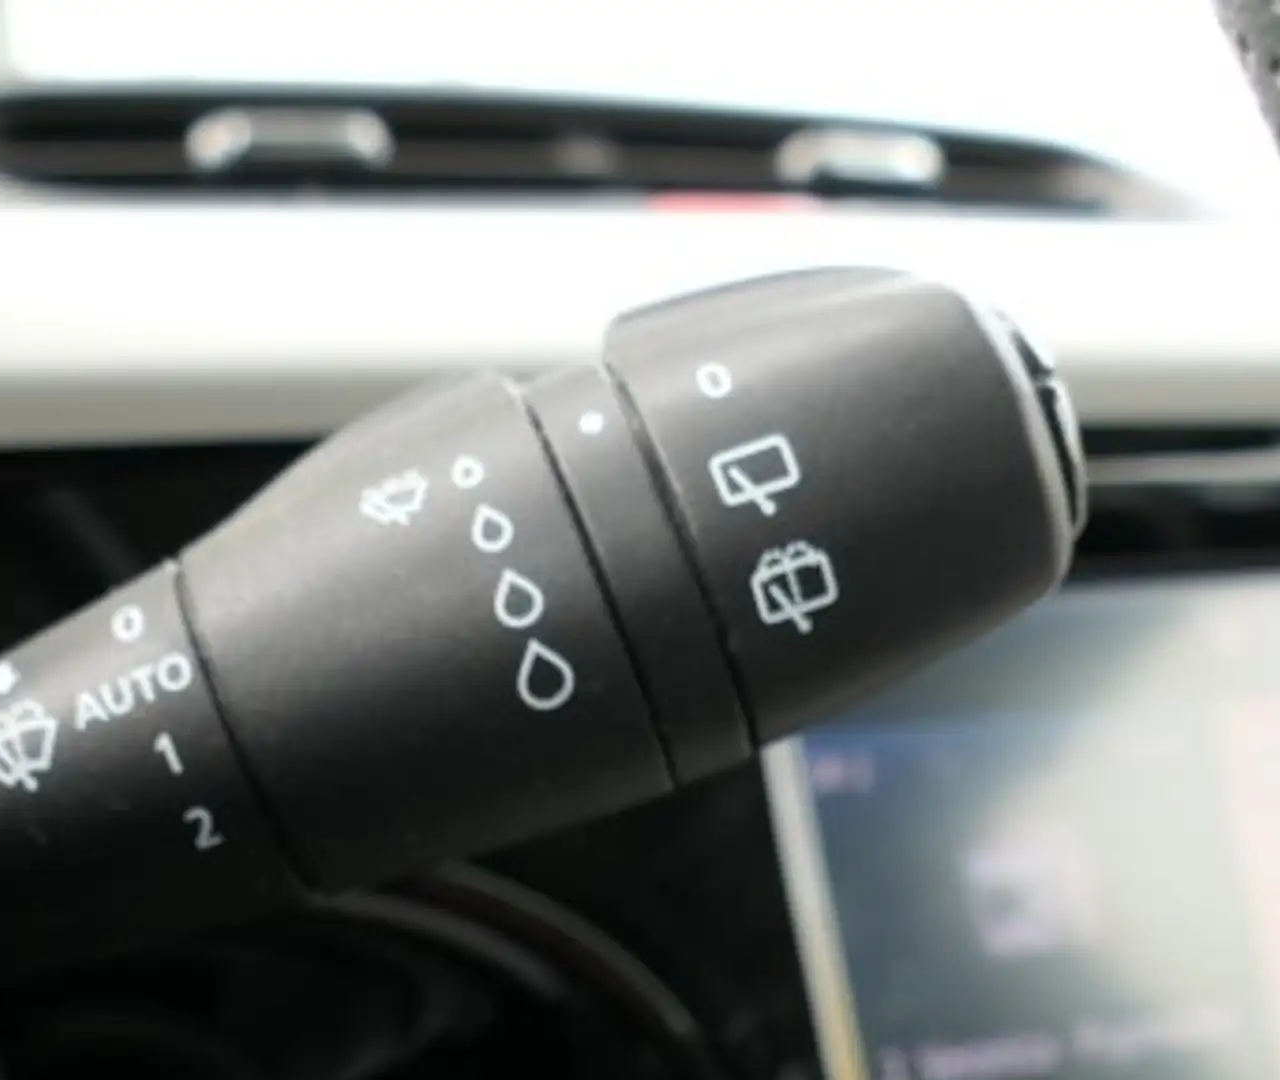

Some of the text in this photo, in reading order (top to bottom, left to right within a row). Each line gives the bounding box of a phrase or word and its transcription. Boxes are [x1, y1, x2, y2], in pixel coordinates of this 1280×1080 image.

[74, 652, 192, 731] AUTO
[153, 731, 184, 776] 1
[182, 806, 225, 852] 2
